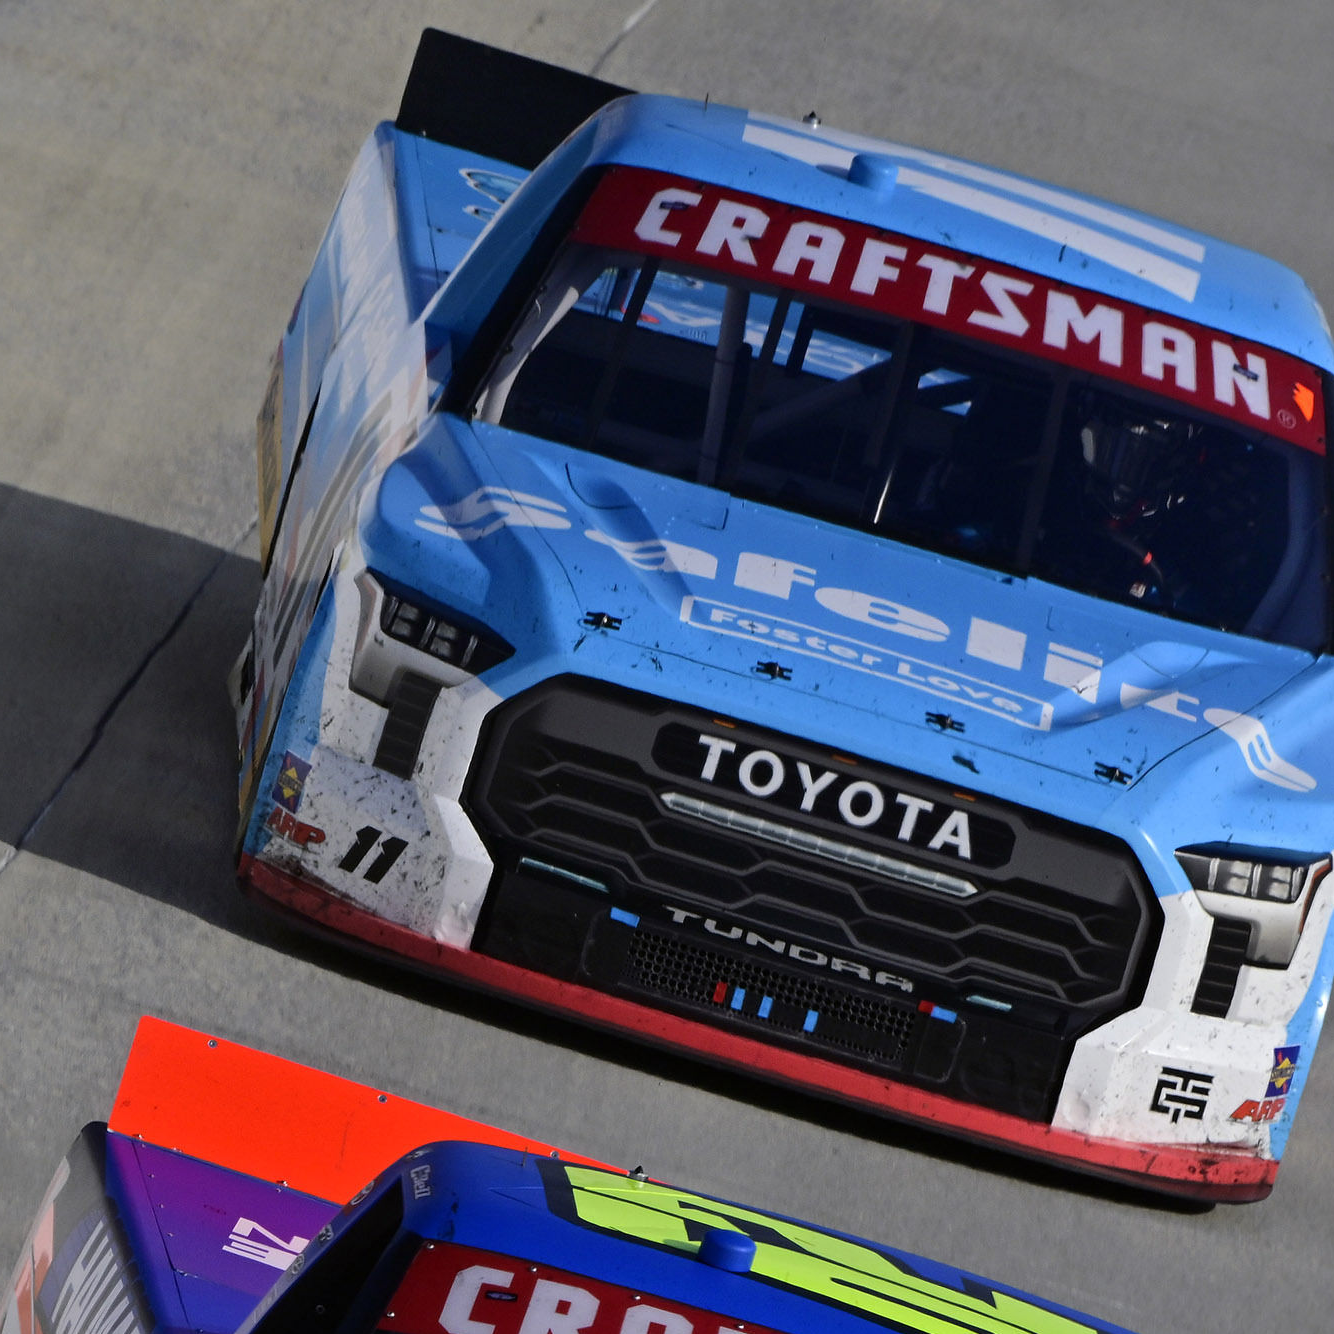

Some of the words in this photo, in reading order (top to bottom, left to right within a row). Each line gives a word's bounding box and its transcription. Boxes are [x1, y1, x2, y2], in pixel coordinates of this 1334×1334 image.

[633, 188, 1272, 421] CRAFTSMAN
[710, 608, 882, 666] Foster
[896, 661, 1024, 715] Love
[697, 734, 972, 861] TOYOTA
[337, 825, 410, 885] 11
[663, 904, 915, 994] TUNDRA
[1228, 1097, 1286, 1123] ARP
